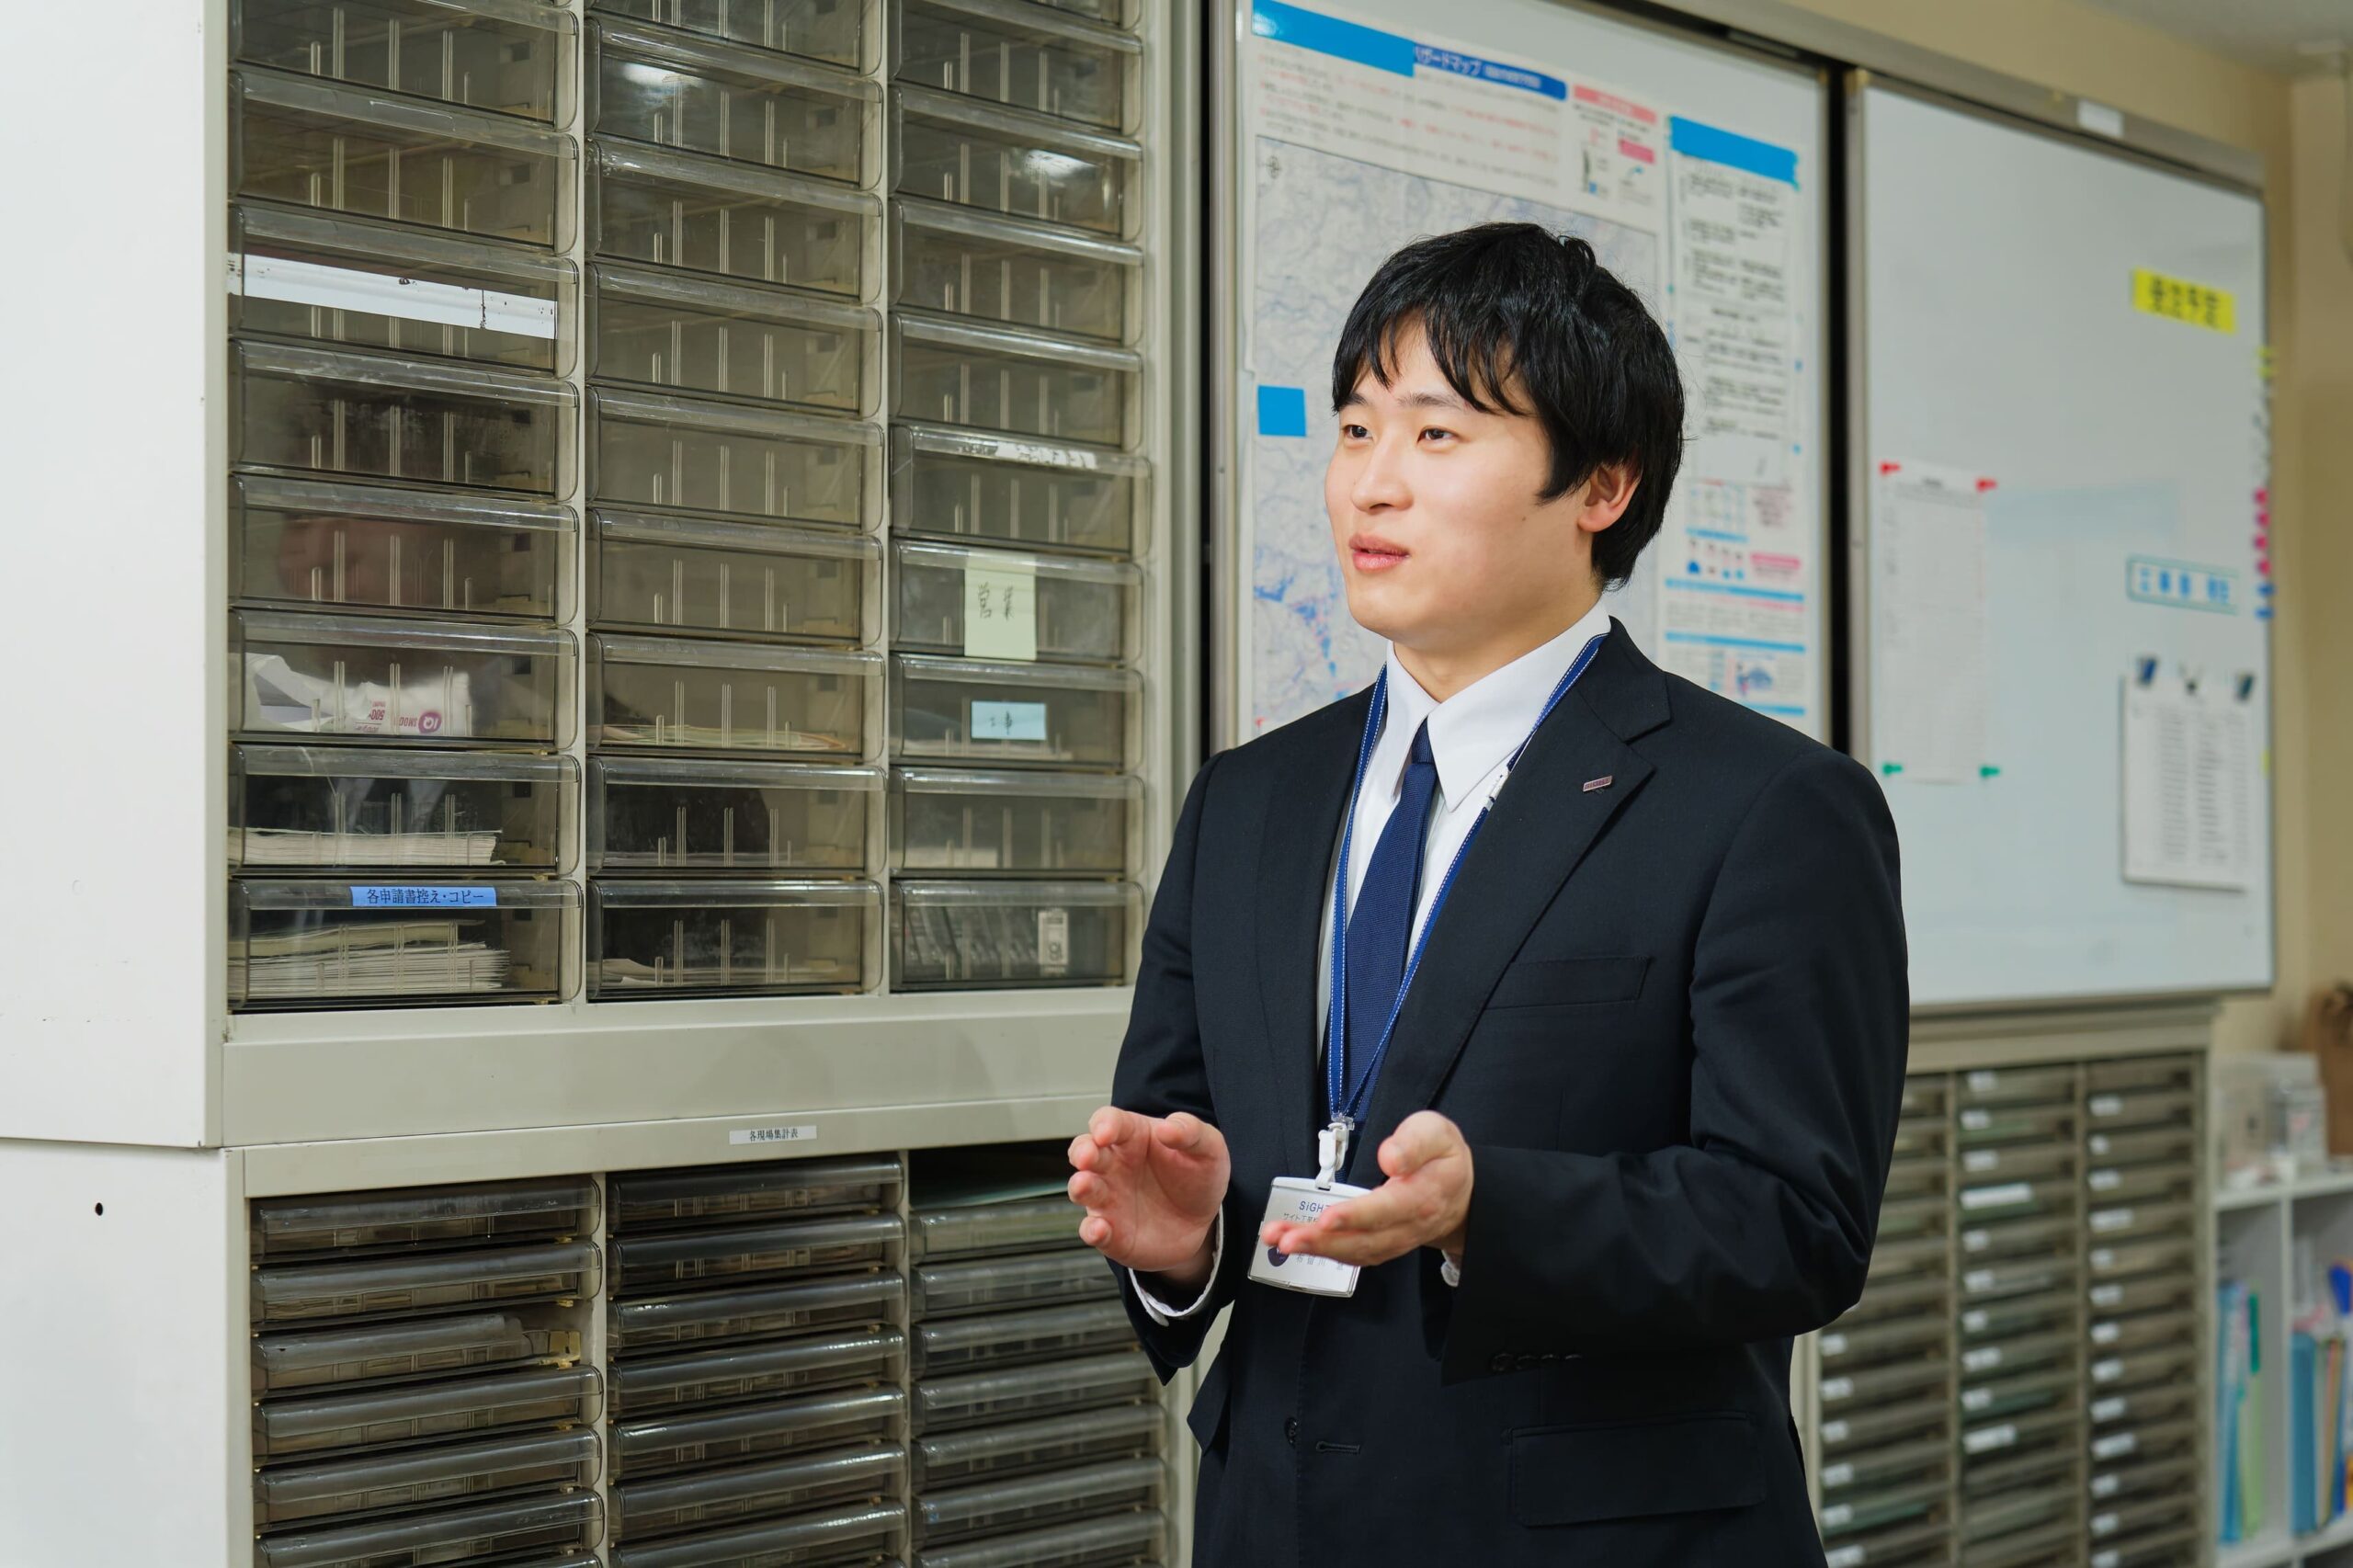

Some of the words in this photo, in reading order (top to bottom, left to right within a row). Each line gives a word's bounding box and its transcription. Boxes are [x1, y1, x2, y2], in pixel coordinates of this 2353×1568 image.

[367, 888, 484, 905] 各申請書控え・コピー
